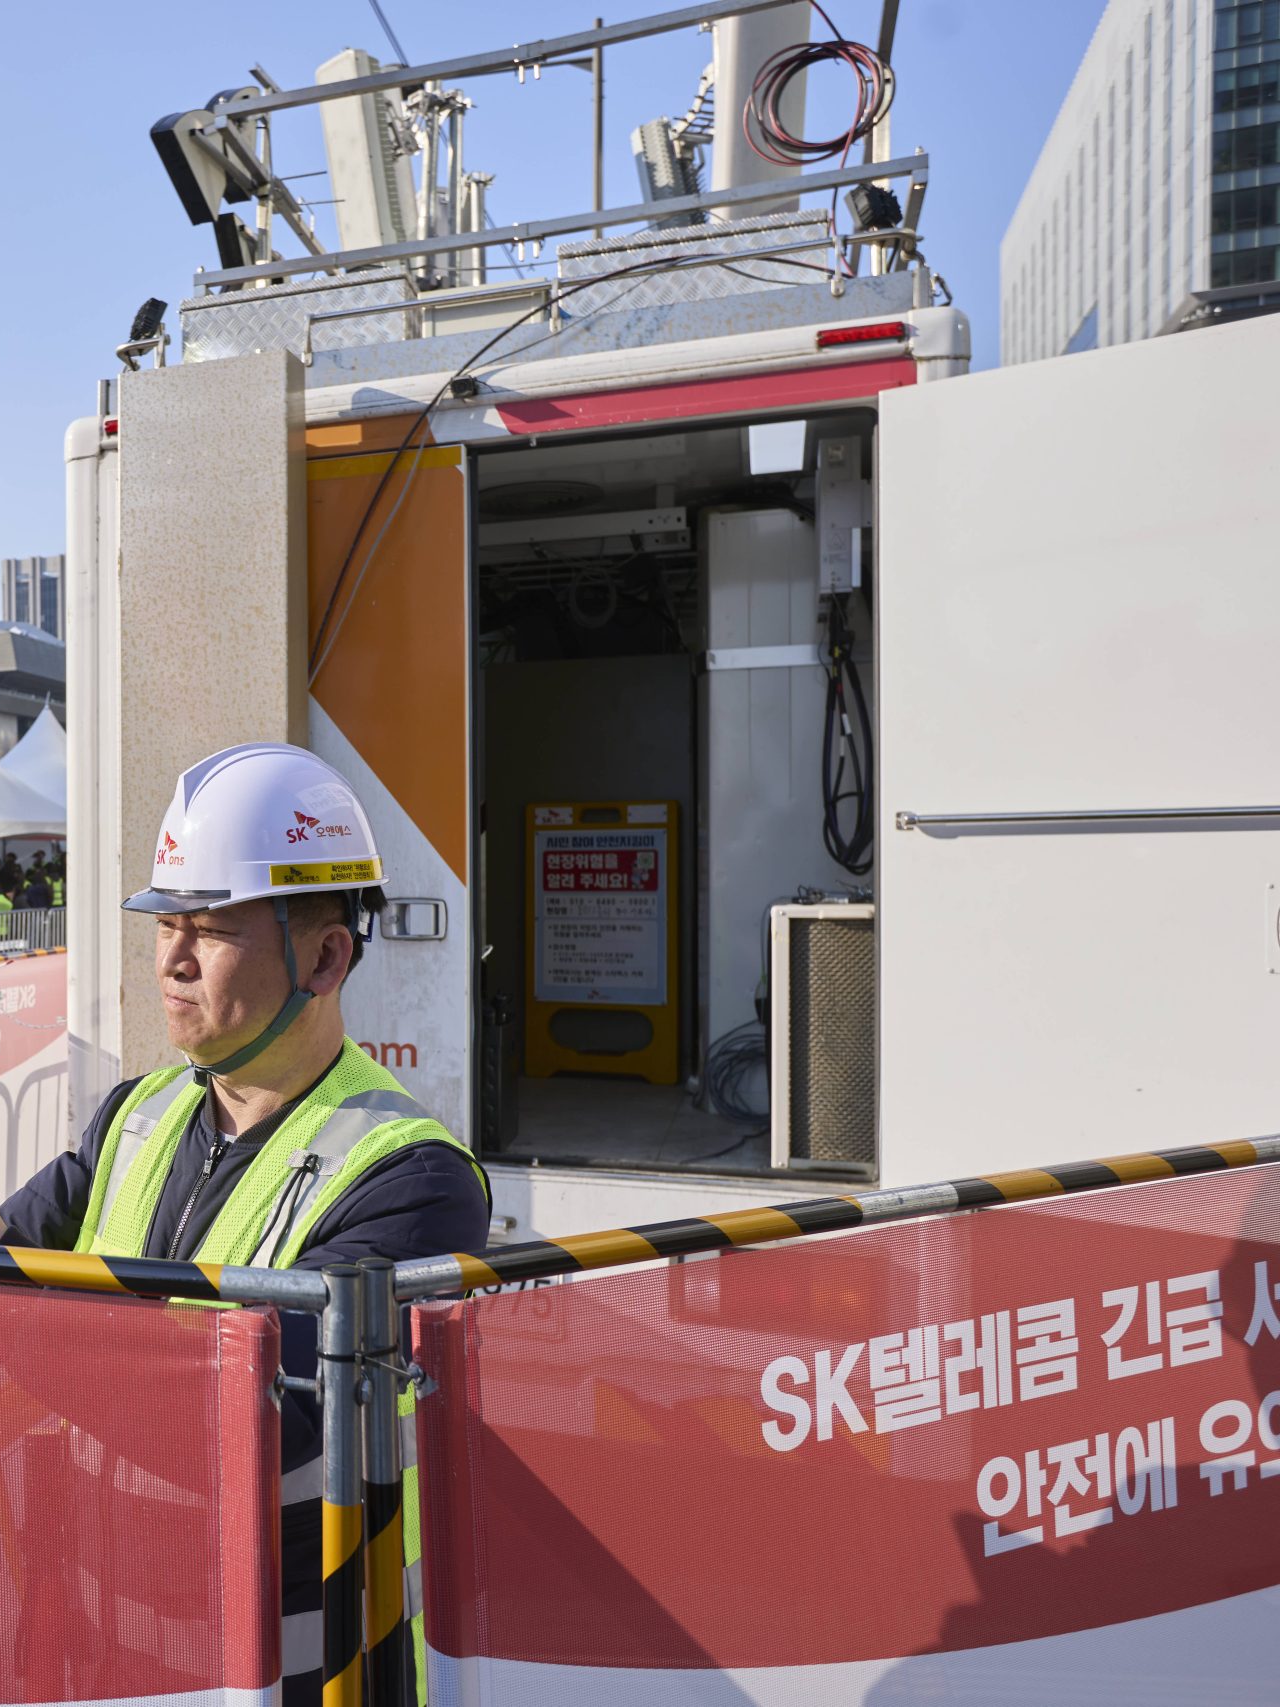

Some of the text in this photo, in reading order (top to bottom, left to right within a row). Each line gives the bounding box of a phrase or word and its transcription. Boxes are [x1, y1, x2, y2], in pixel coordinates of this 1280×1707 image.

[286, 825, 352, 844] SK 오앤에스
[156, 849, 185, 866] SK ons
[546, 853, 619, 870] 현장위험을
[546, 873, 628, 889] 알려 주세요!
[760, 1297, 1079, 1452] SK텔레콤
[1101, 1269, 1223, 1381] 긴급
[976, 1416, 1178, 1558] 안전에
